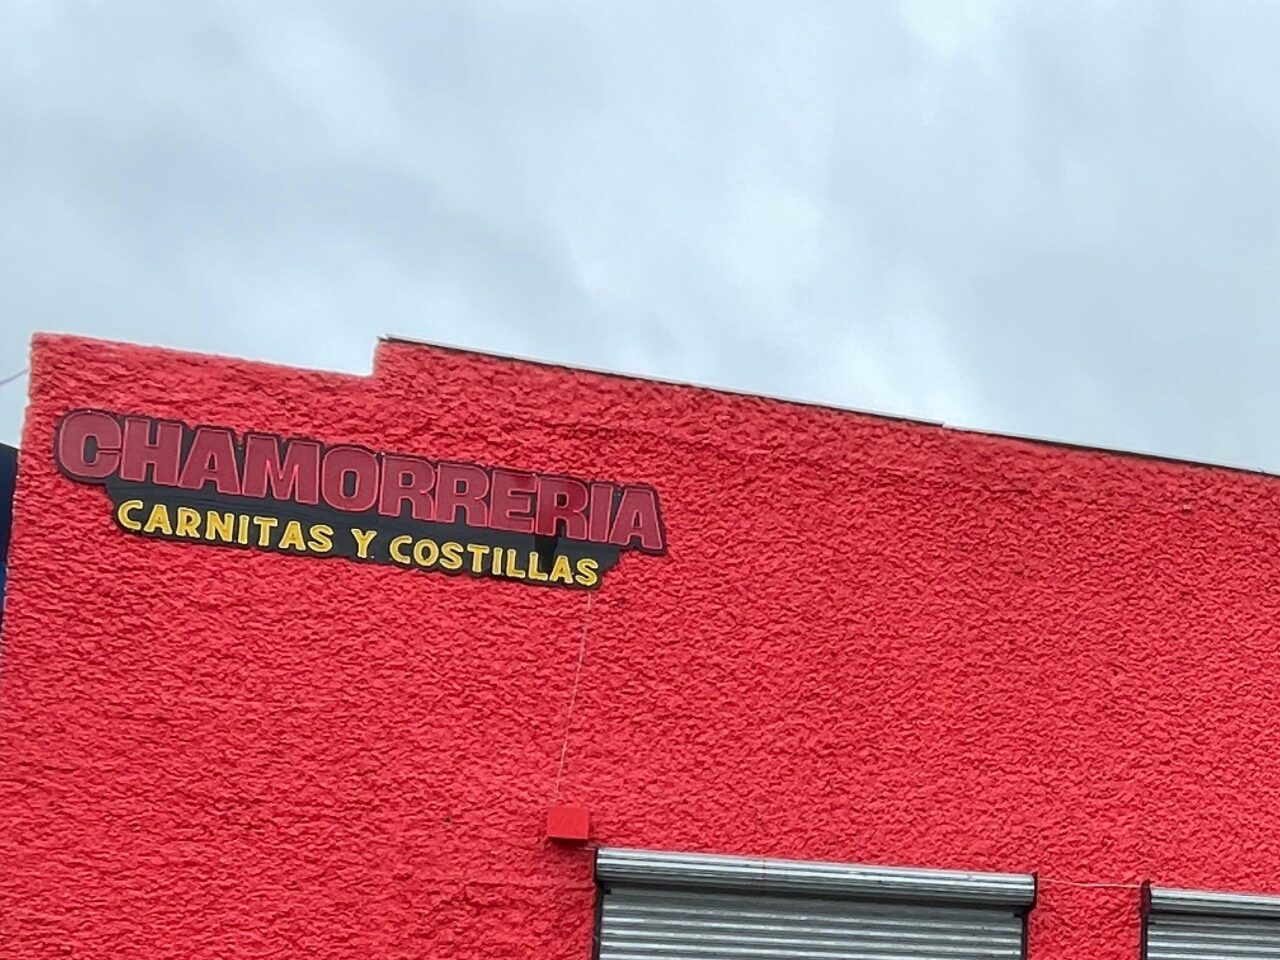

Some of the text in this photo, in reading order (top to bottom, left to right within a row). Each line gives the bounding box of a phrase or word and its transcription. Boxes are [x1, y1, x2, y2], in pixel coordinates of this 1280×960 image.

[58, 410, 663, 550] CHAMORRERIA
[117, 500, 599, 587] CARNITAS Y COSTILLAS
